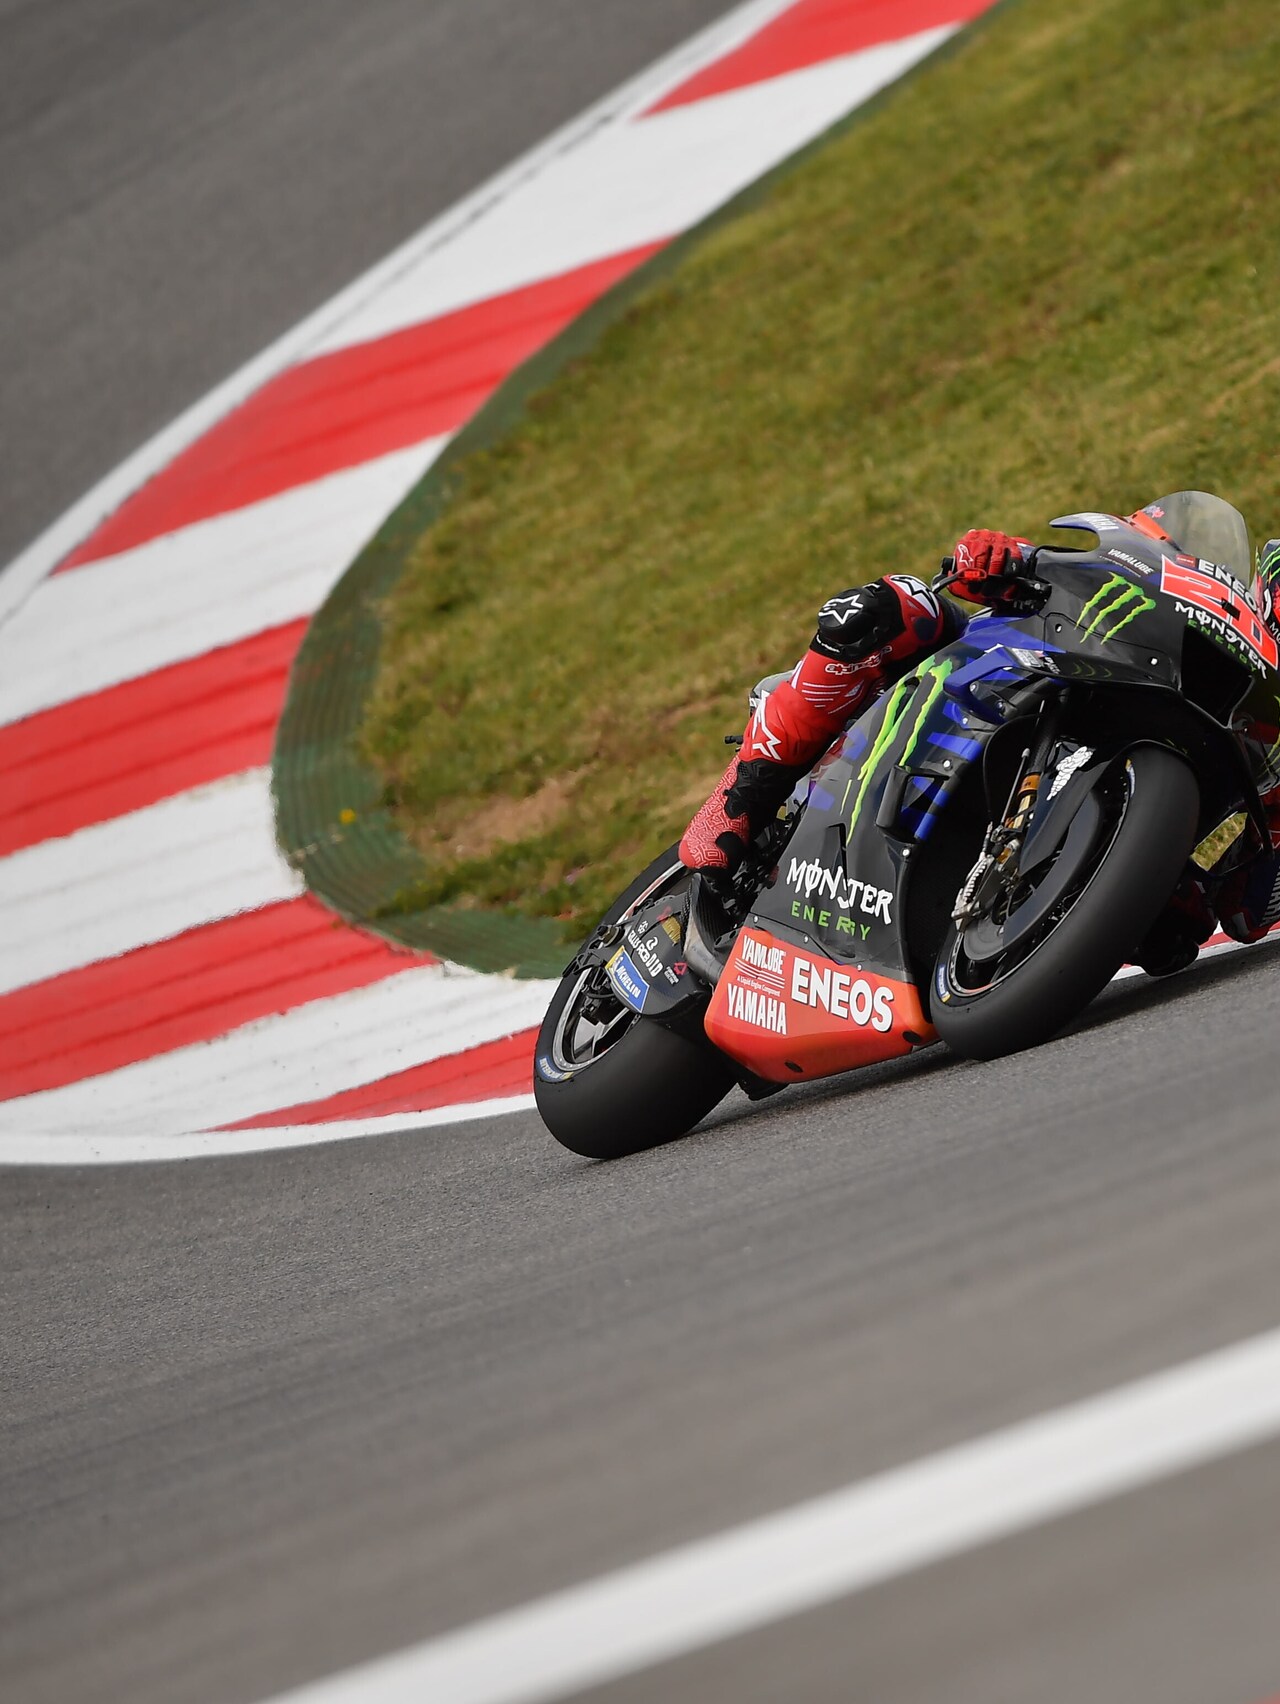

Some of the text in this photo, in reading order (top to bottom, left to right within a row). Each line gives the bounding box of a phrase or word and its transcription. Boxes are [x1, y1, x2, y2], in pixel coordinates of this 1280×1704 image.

[1107, 548, 1155, 575] YAMALUBE
[1175, 601, 1267, 680] MONSTER
[645, 953, 664, 977] DID
[727, 983, 787, 1036] YAMAHA
[791, 957, 894, 1032] ENEOS
